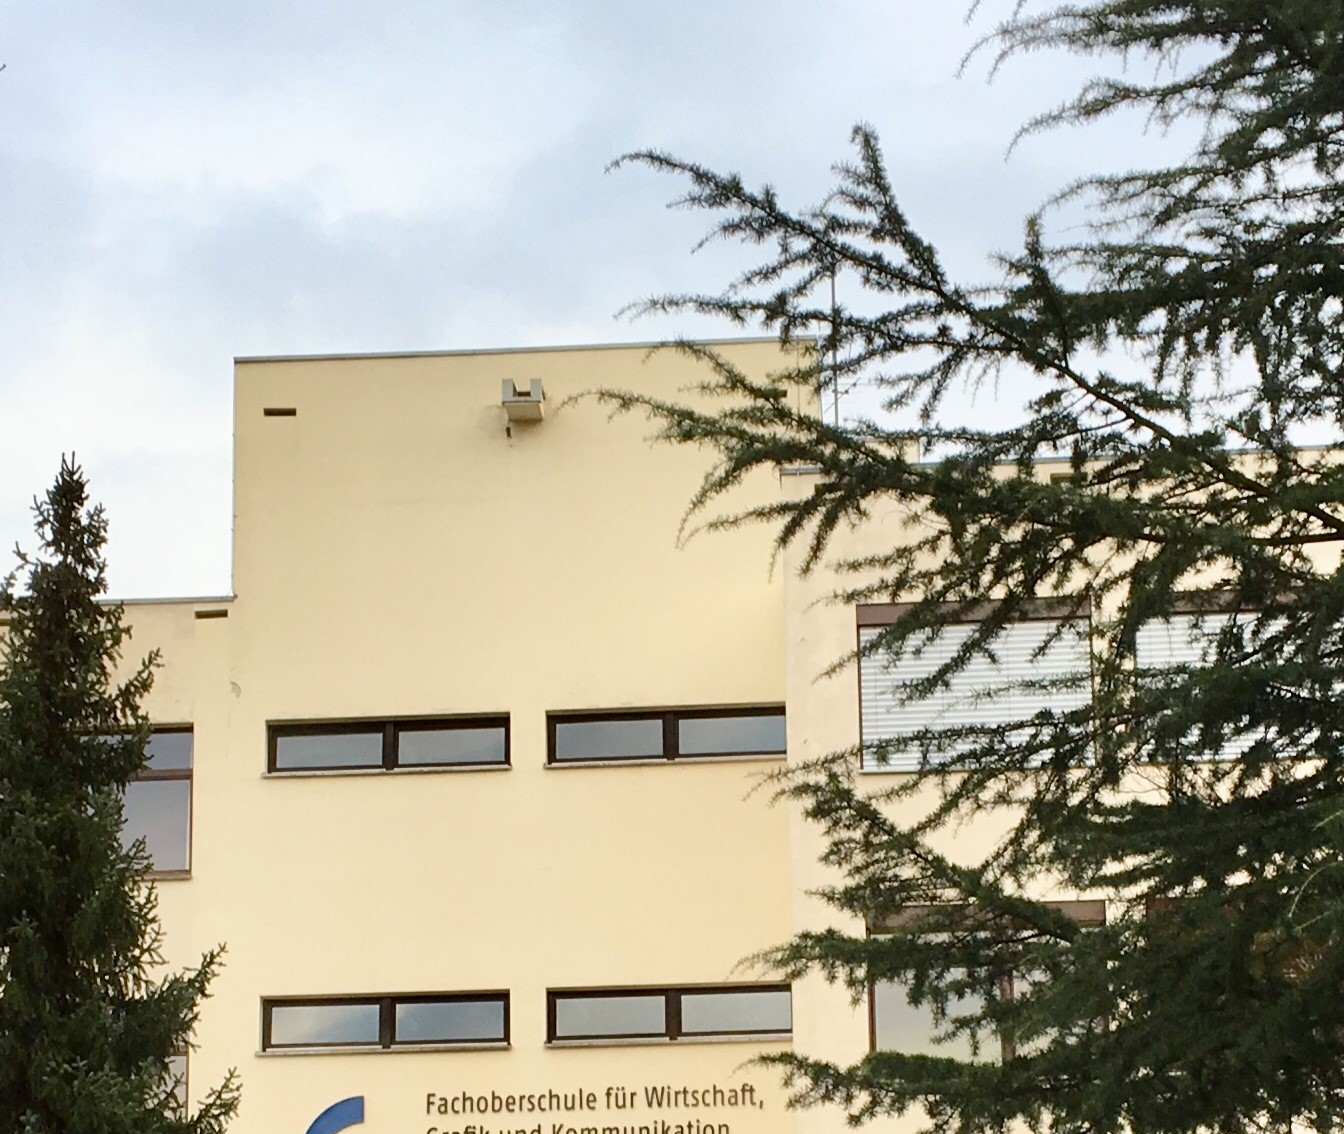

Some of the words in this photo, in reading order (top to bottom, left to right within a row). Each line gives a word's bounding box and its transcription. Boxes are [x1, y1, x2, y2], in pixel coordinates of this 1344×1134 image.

[426, 1087, 597, 1115] Fachoberschule
[605, 1086, 637, 1110] für
[644, 1083, 764, 1110] Wirtschaft,
